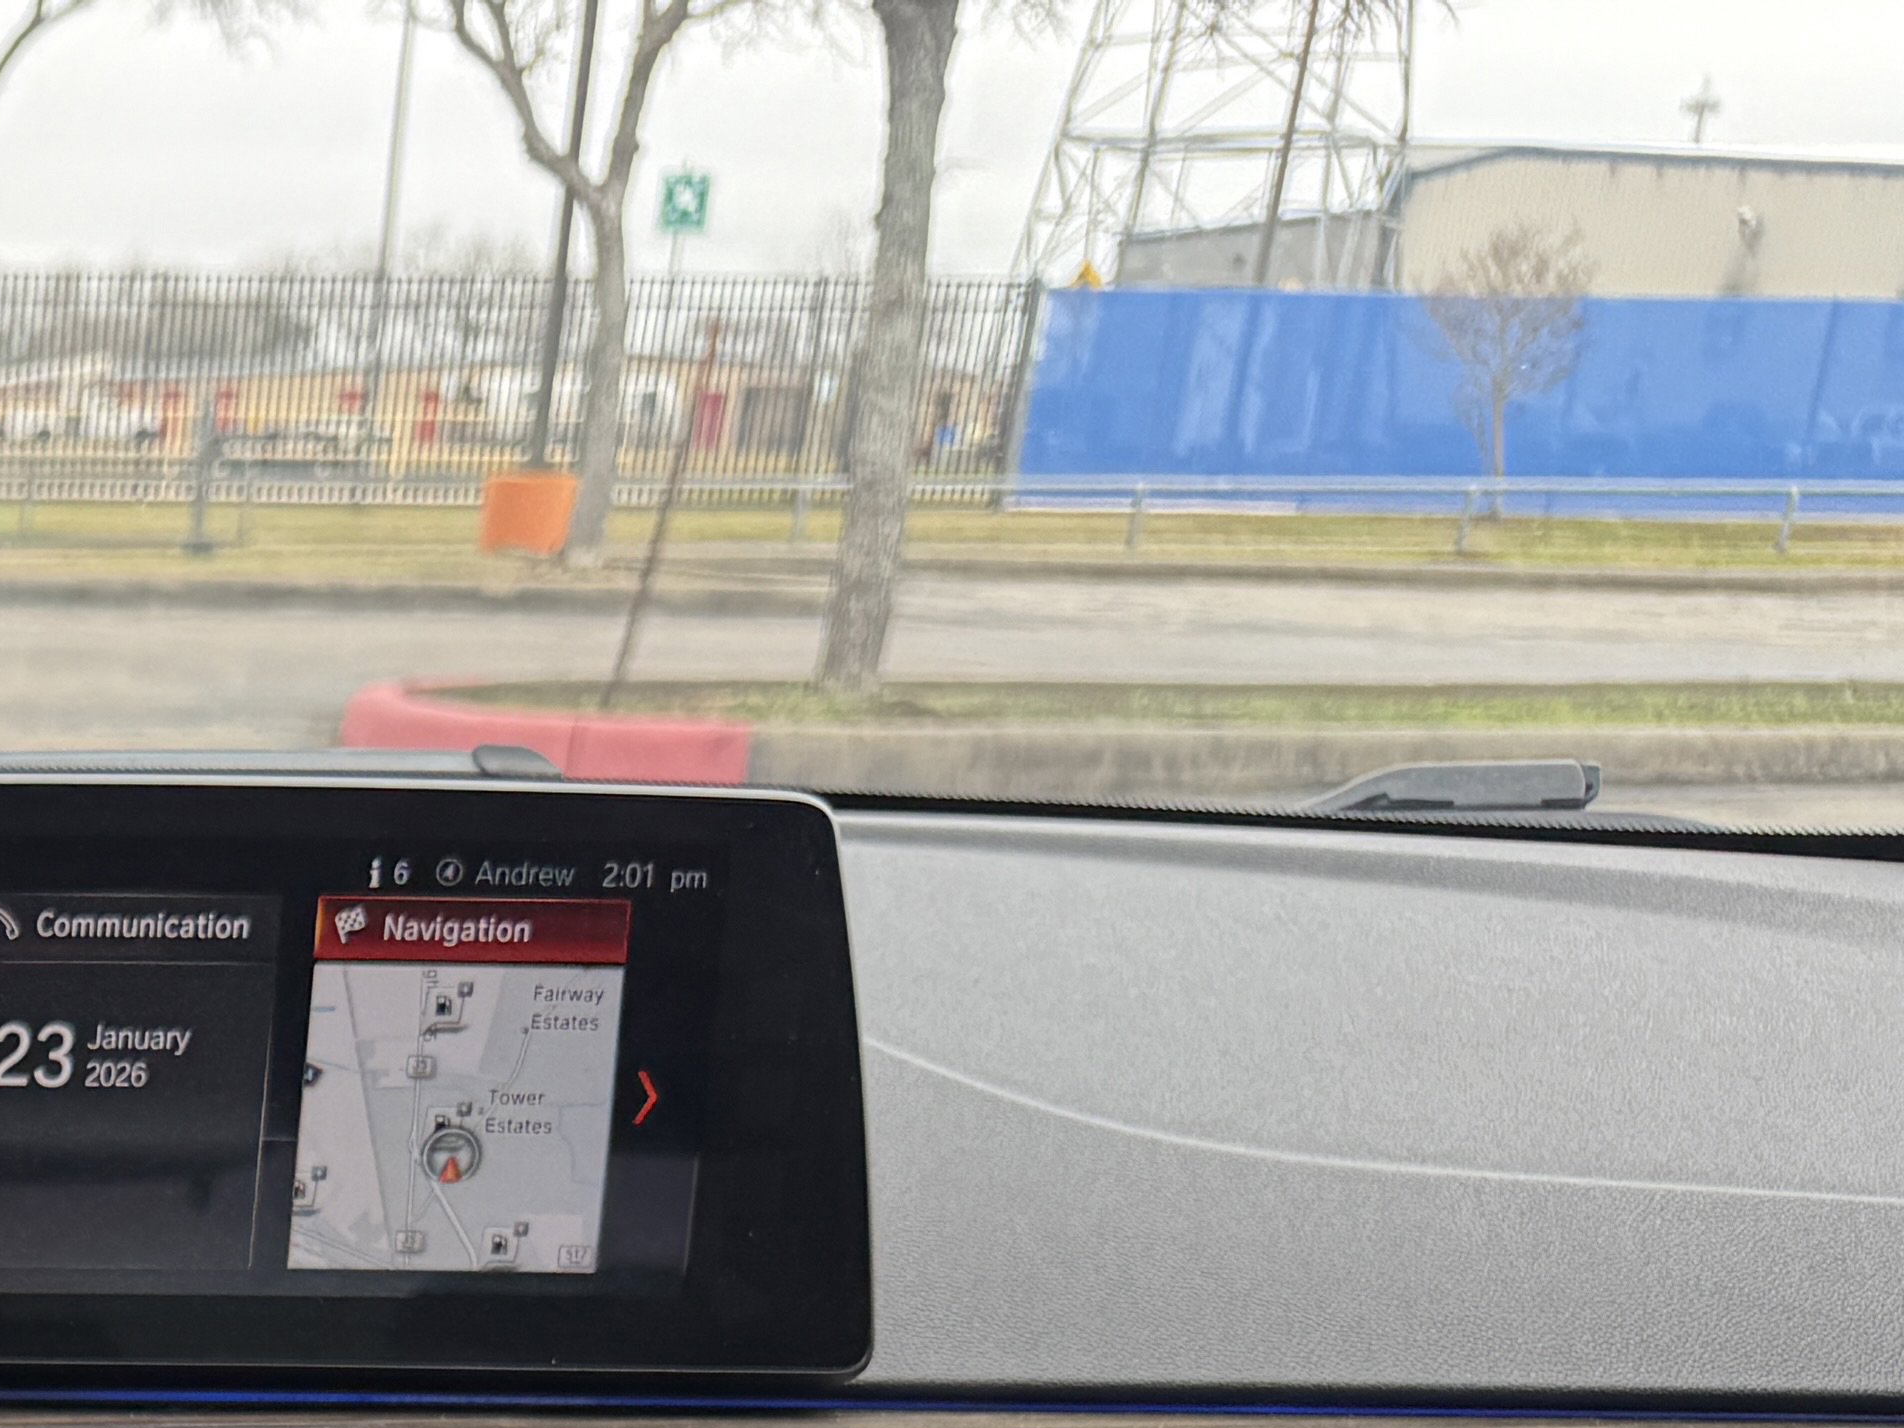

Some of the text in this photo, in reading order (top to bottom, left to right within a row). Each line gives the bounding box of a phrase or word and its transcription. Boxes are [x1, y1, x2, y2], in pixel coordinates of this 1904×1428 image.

[394, 859, 710, 893] 6 Andrew 2:01 pm
[36, 907, 251, 940] Communication
[383, 913, 532, 946] Navigation
[533, 984, 606, 1006] Fairway
[530, 1014, 600, 1032] Estates
[87, 1022, 192, 1056] January
[85, 1060, 150, 1088] 2026
[489, 1089, 546, 1107] Tower
[485, 1117, 553, 1135] Estates
